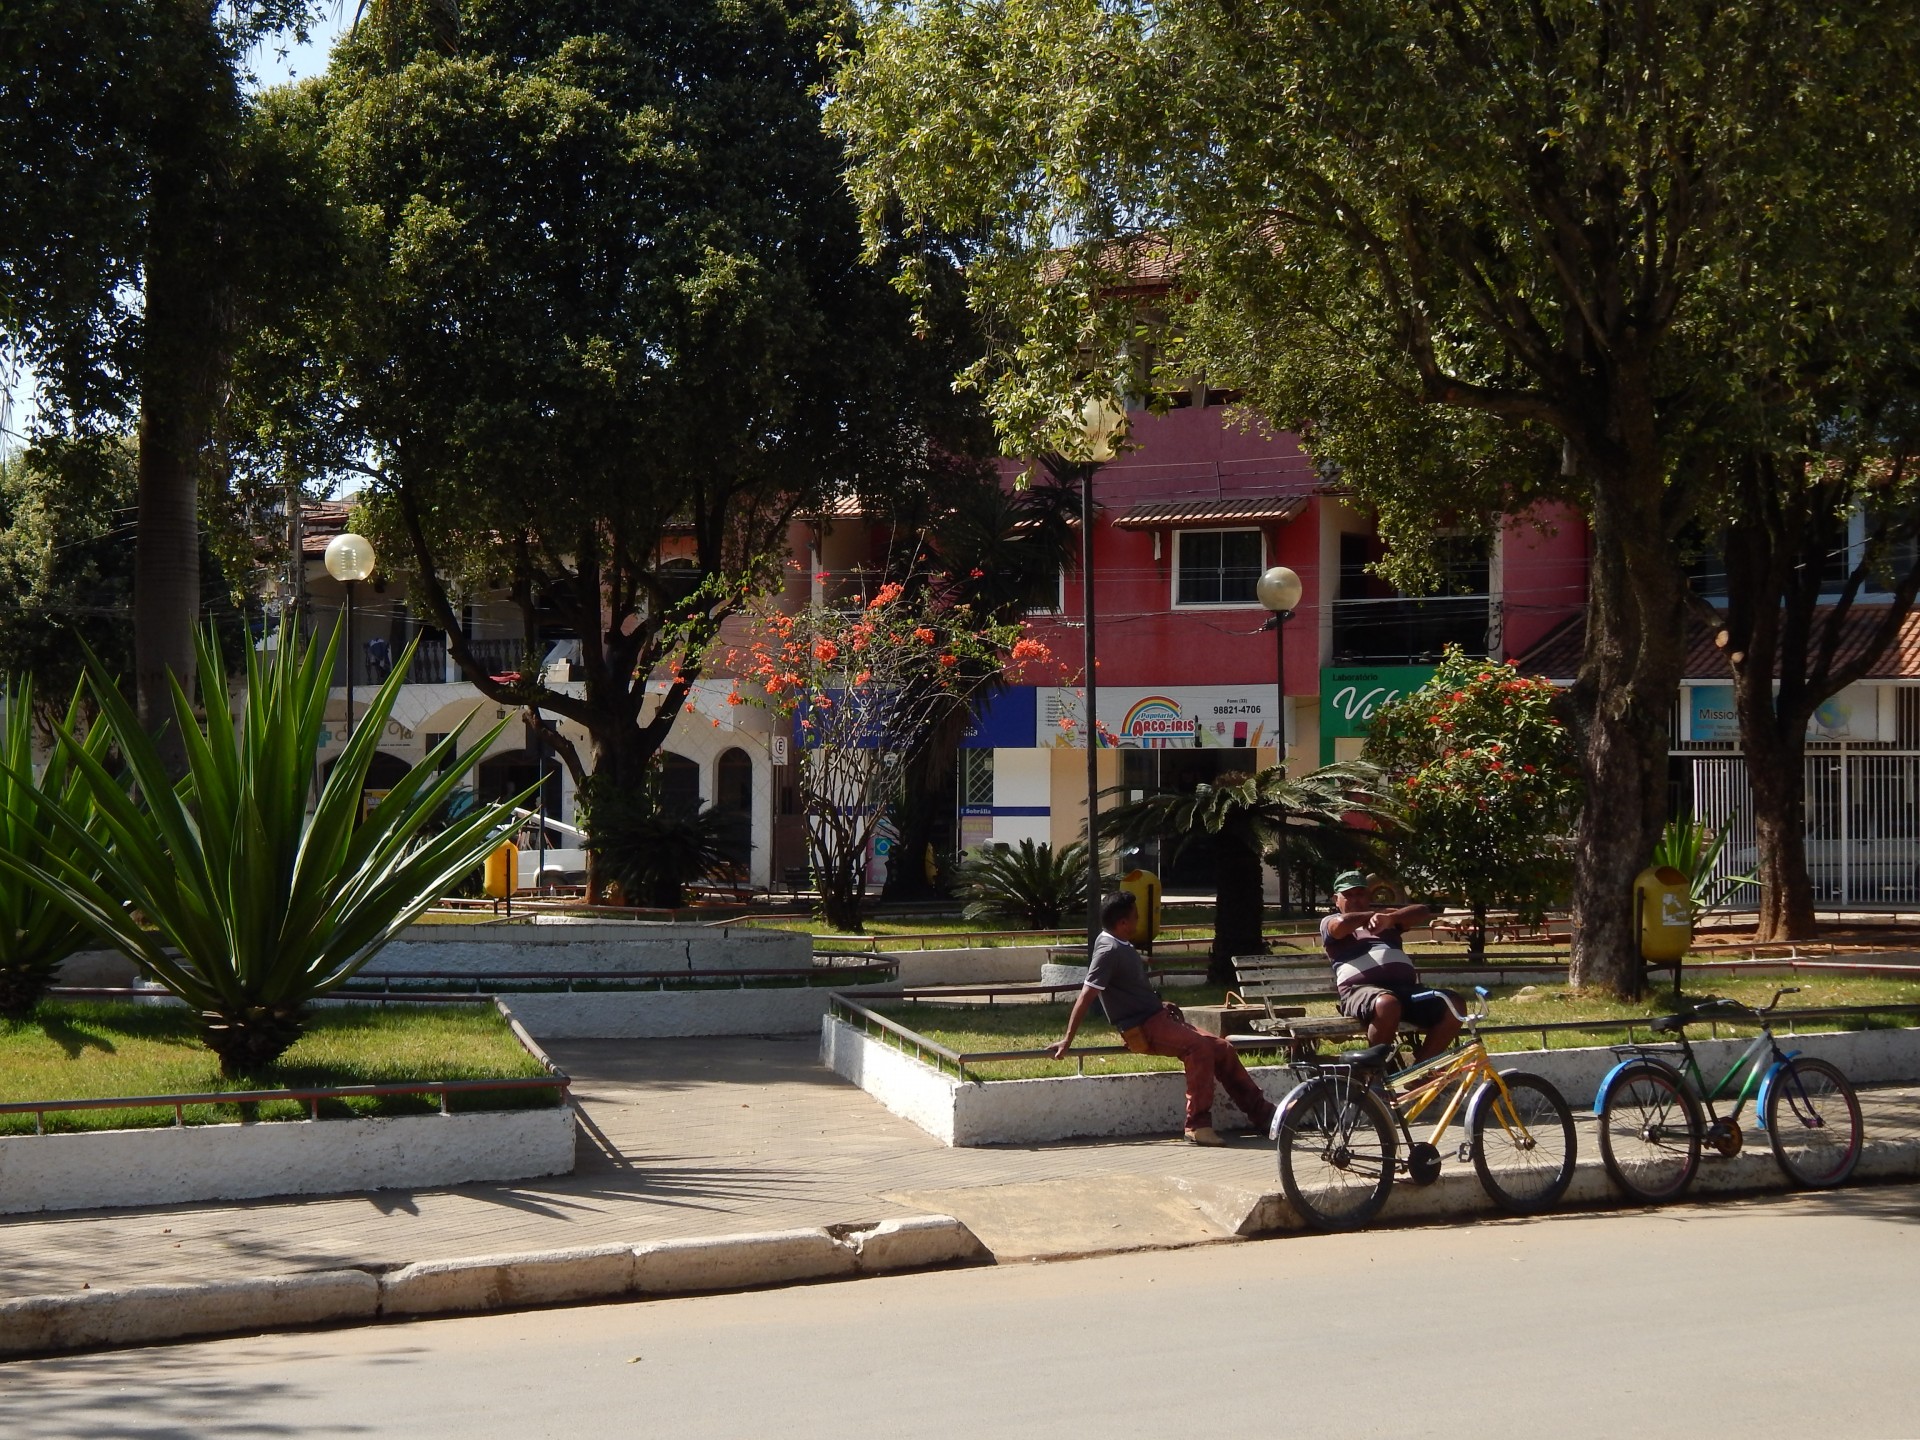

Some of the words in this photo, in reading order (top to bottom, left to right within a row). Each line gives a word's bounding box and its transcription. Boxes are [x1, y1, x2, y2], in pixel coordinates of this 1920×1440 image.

[1333, 673, 1378, 681] Laboratório
[1213, 705, 1261, 714] 98821-4706
[1140, 712, 1174, 720] Papelaria
[1132, 717, 1195, 736] ARCO-ÍRIS
[778, 741, 783, 751] E
